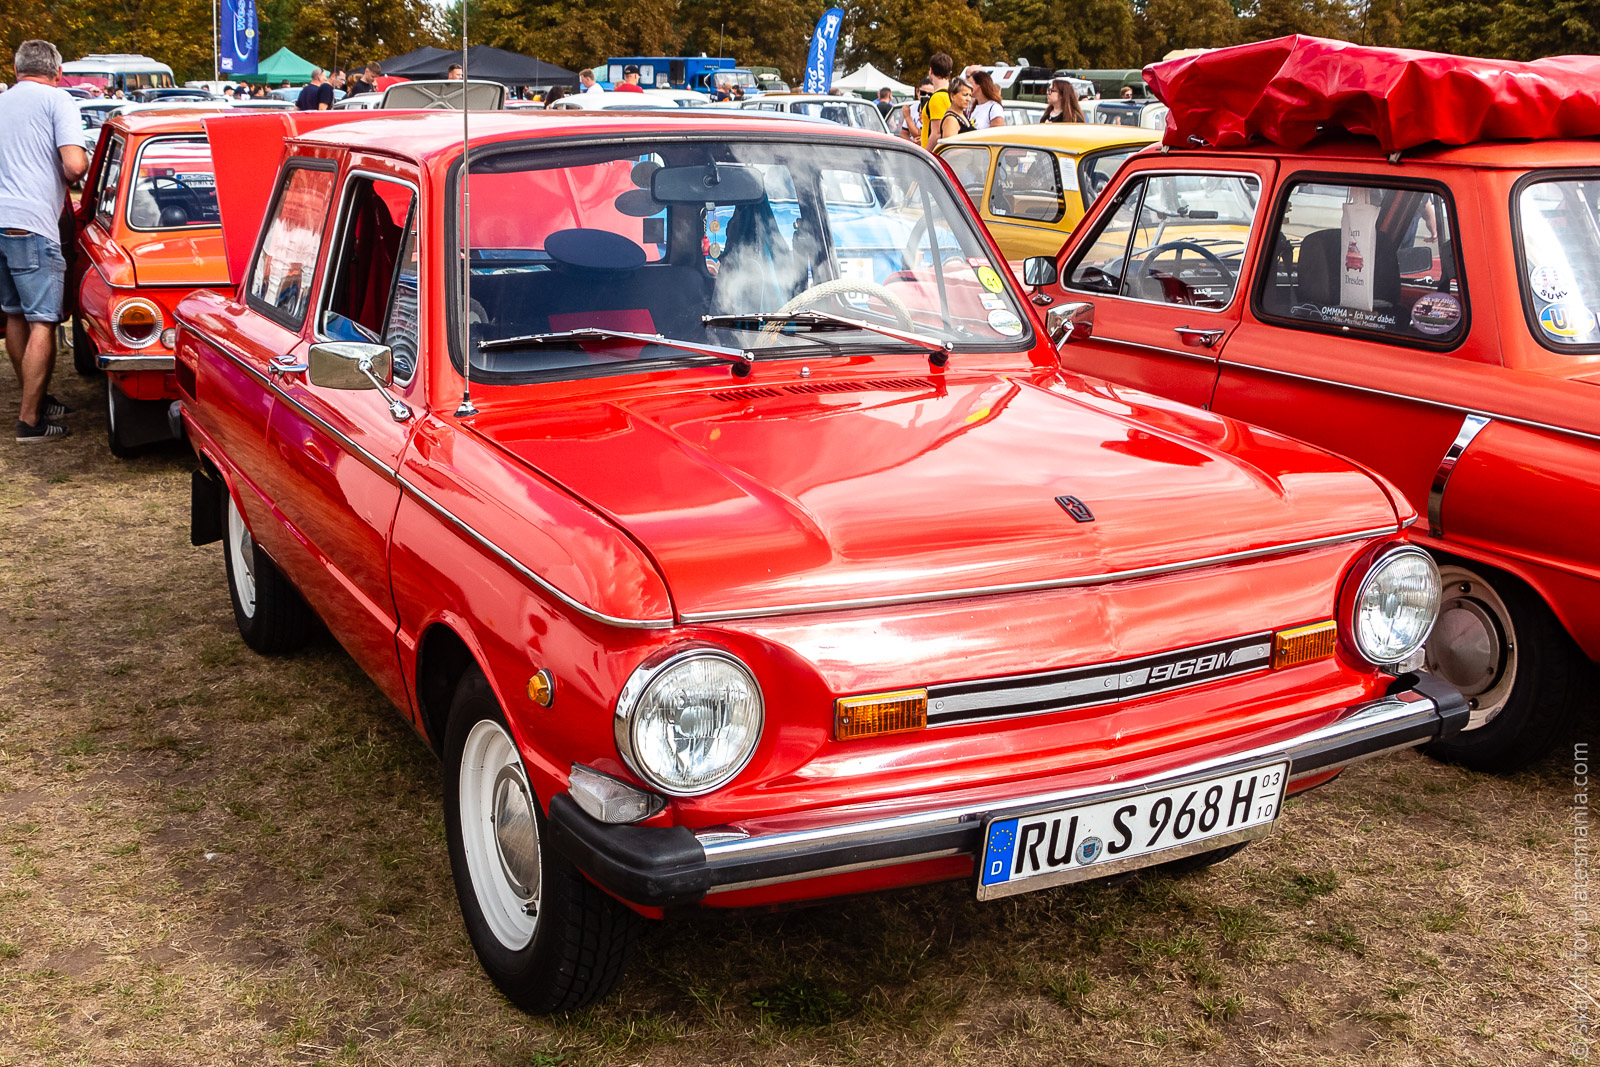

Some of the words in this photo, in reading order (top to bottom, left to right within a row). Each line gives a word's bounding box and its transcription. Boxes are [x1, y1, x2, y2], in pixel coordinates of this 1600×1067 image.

[1345, 275, 1364, 286] Dresden
[1540, 289, 1568, 300] SUHL
[1321, 306, 1348, 318] OMMMA
[1354, 310, 1365, 321] Ich
[1365, 313, 1377, 322] war
[1377, 315, 1396, 325] dabei.
[1149, 650, 1238, 684] 968M
[1262, 771, 1281, 788] 03
[1256, 803, 1273, 820] 10
[1014, 815, 1079, 875] RU
[990, 860, 1003, 876] D
